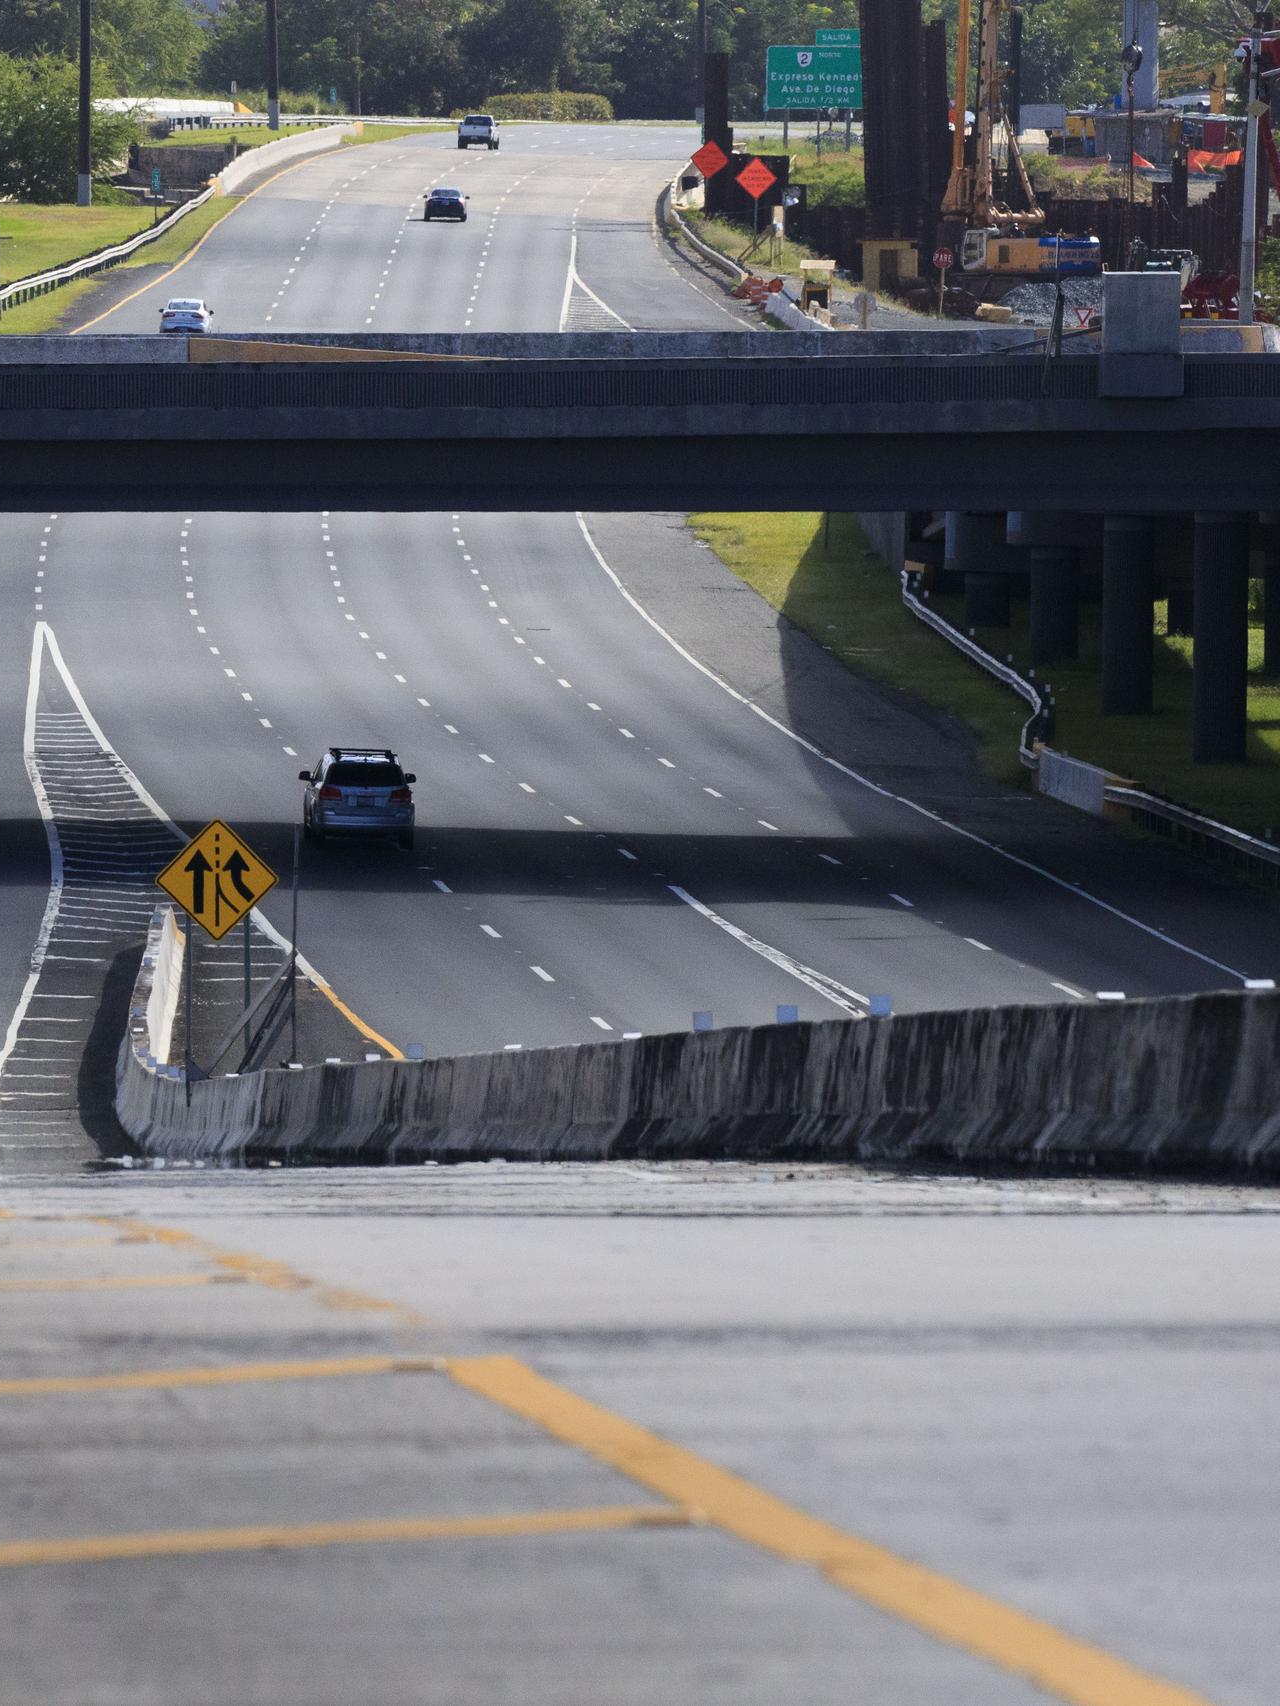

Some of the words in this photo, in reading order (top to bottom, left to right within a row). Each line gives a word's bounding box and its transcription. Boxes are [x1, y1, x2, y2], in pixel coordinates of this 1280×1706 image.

[800, 53, 808, 65] 2
[771, 72, 814, 82] Expreso
[781, 85, 803, 93] Ave.
[806, 85, 819, 93] De
[825, 84, 855, 94] Diego
[935, 253, 952, 263] PARE
